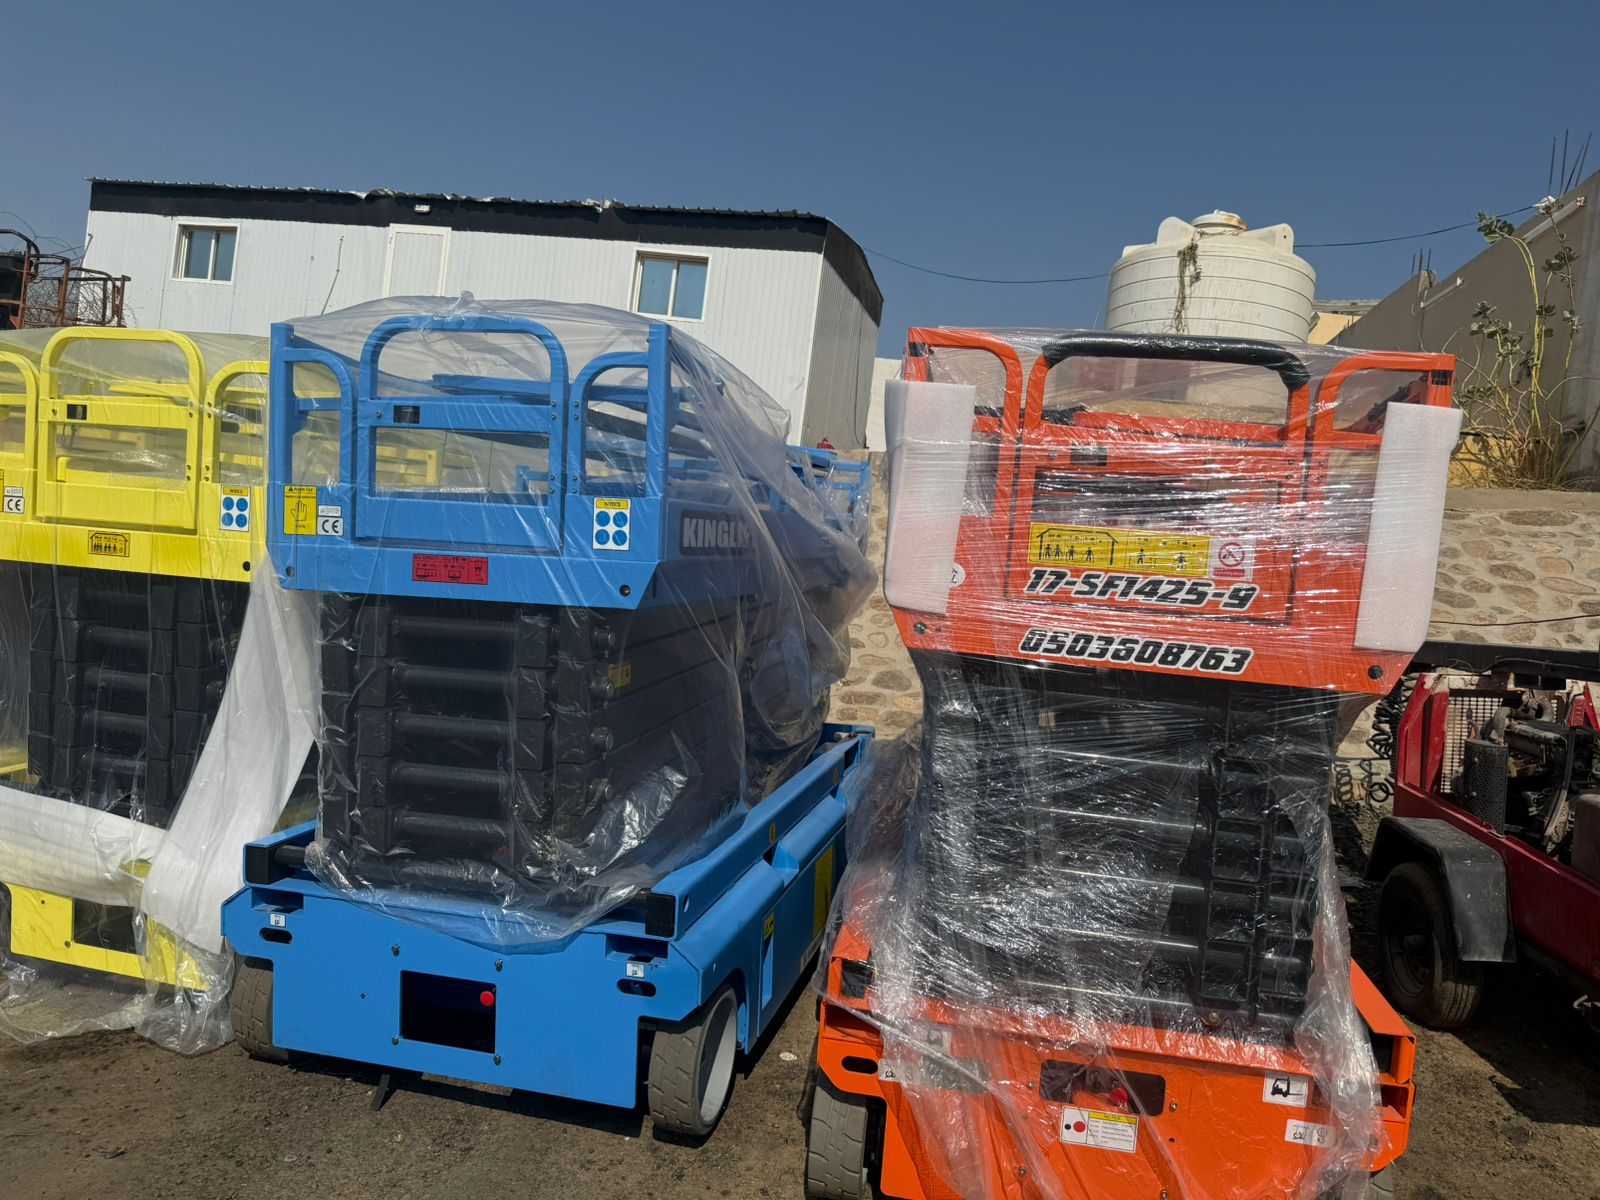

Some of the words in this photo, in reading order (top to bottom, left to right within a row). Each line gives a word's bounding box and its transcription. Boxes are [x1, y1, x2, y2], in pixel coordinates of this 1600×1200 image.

[321, 518, 340, 534] CE
[683, 517, 759, 549] KINGL
[1024, 568, 1258, 610] 17-SF1425-9
[1019, 628, 1254, 675] 0503608763
